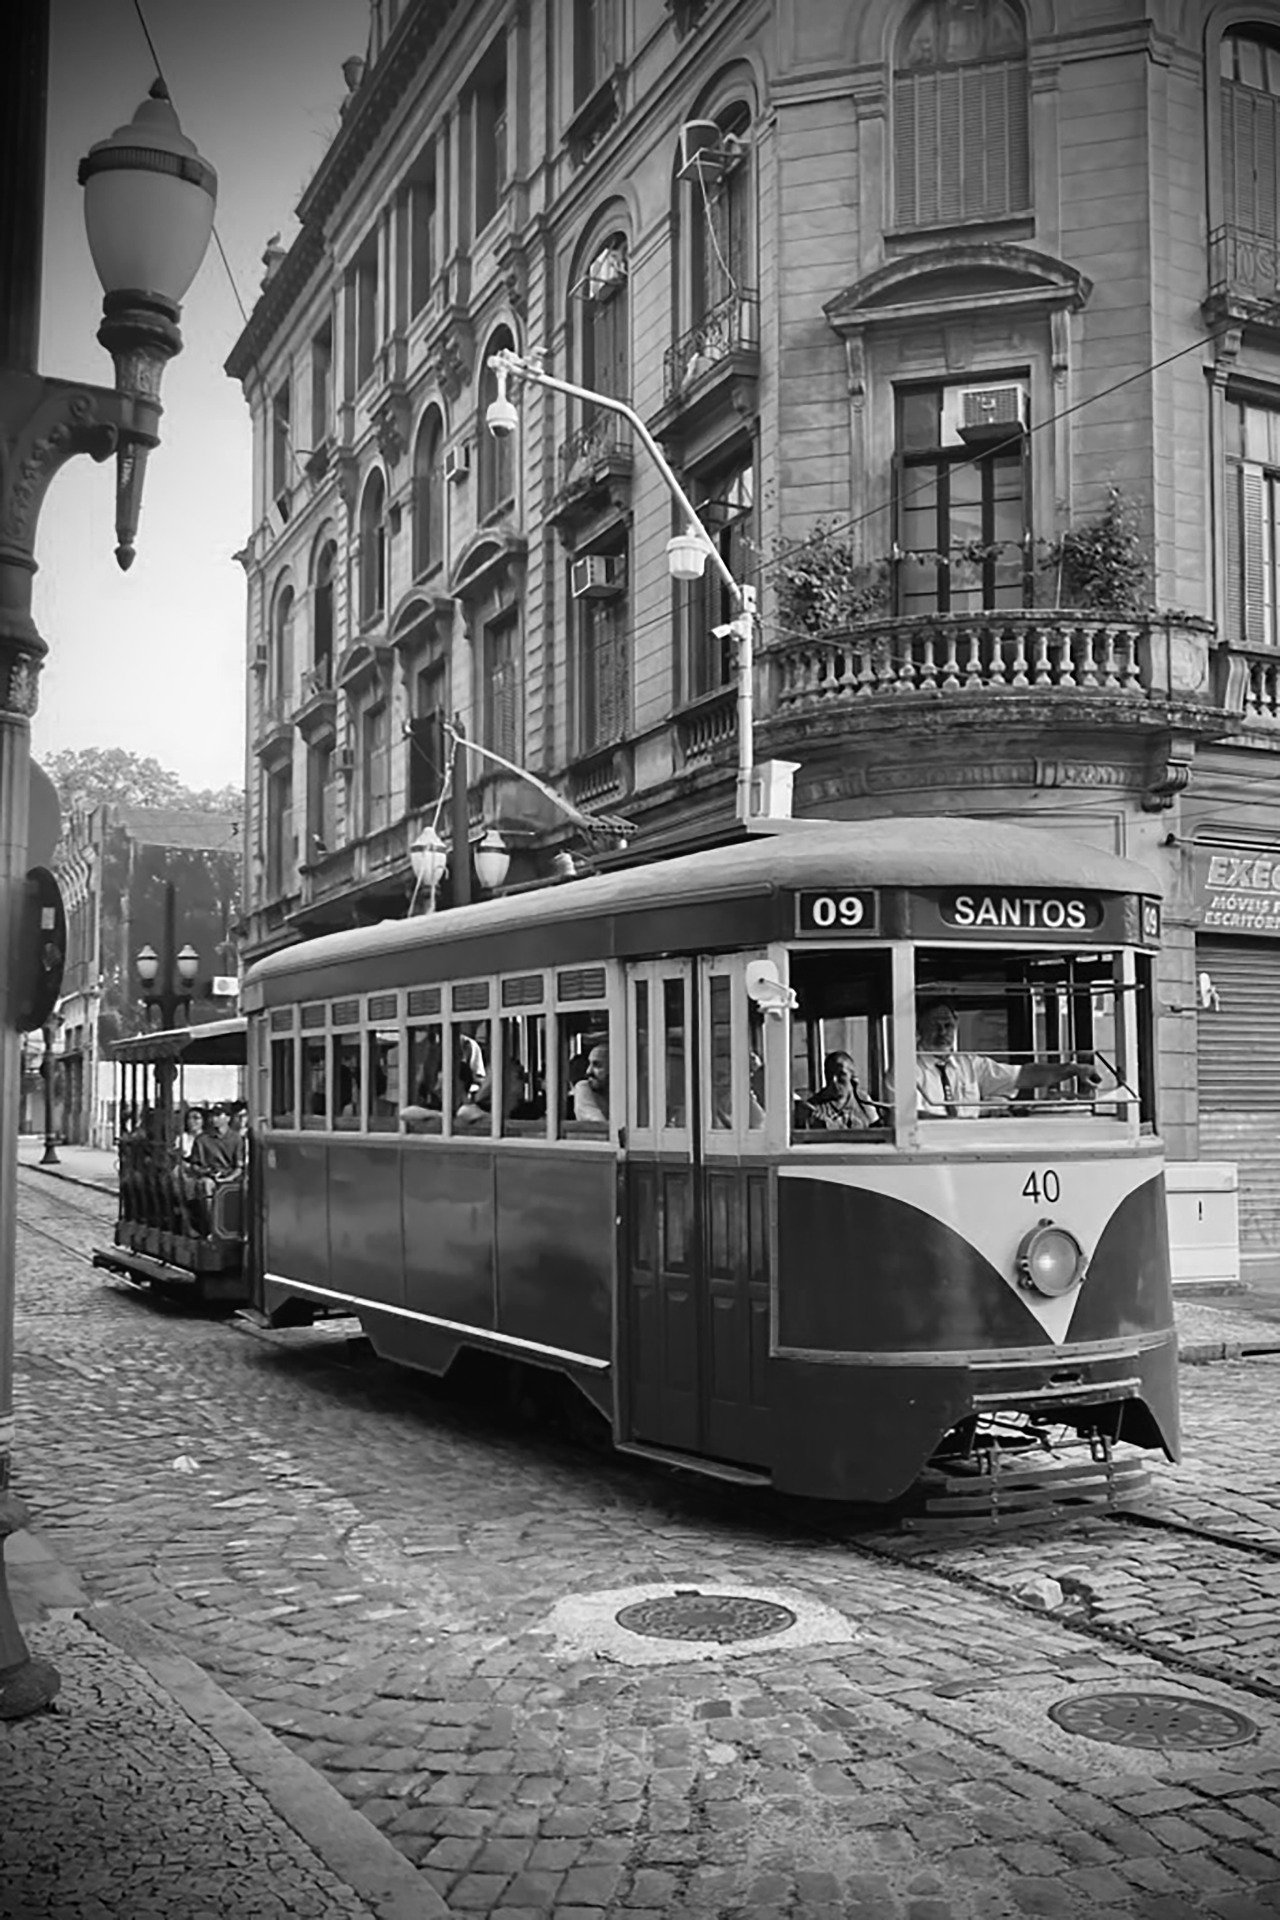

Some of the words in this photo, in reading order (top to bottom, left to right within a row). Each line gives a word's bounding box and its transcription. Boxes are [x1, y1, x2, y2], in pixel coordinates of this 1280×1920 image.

[812, 896, 864, 927] 09
[954, 896, 1086, 929] SANTOS
[1143, 906, 1157, 935] 09
[1022, 1169, 1060, 1204] 40
